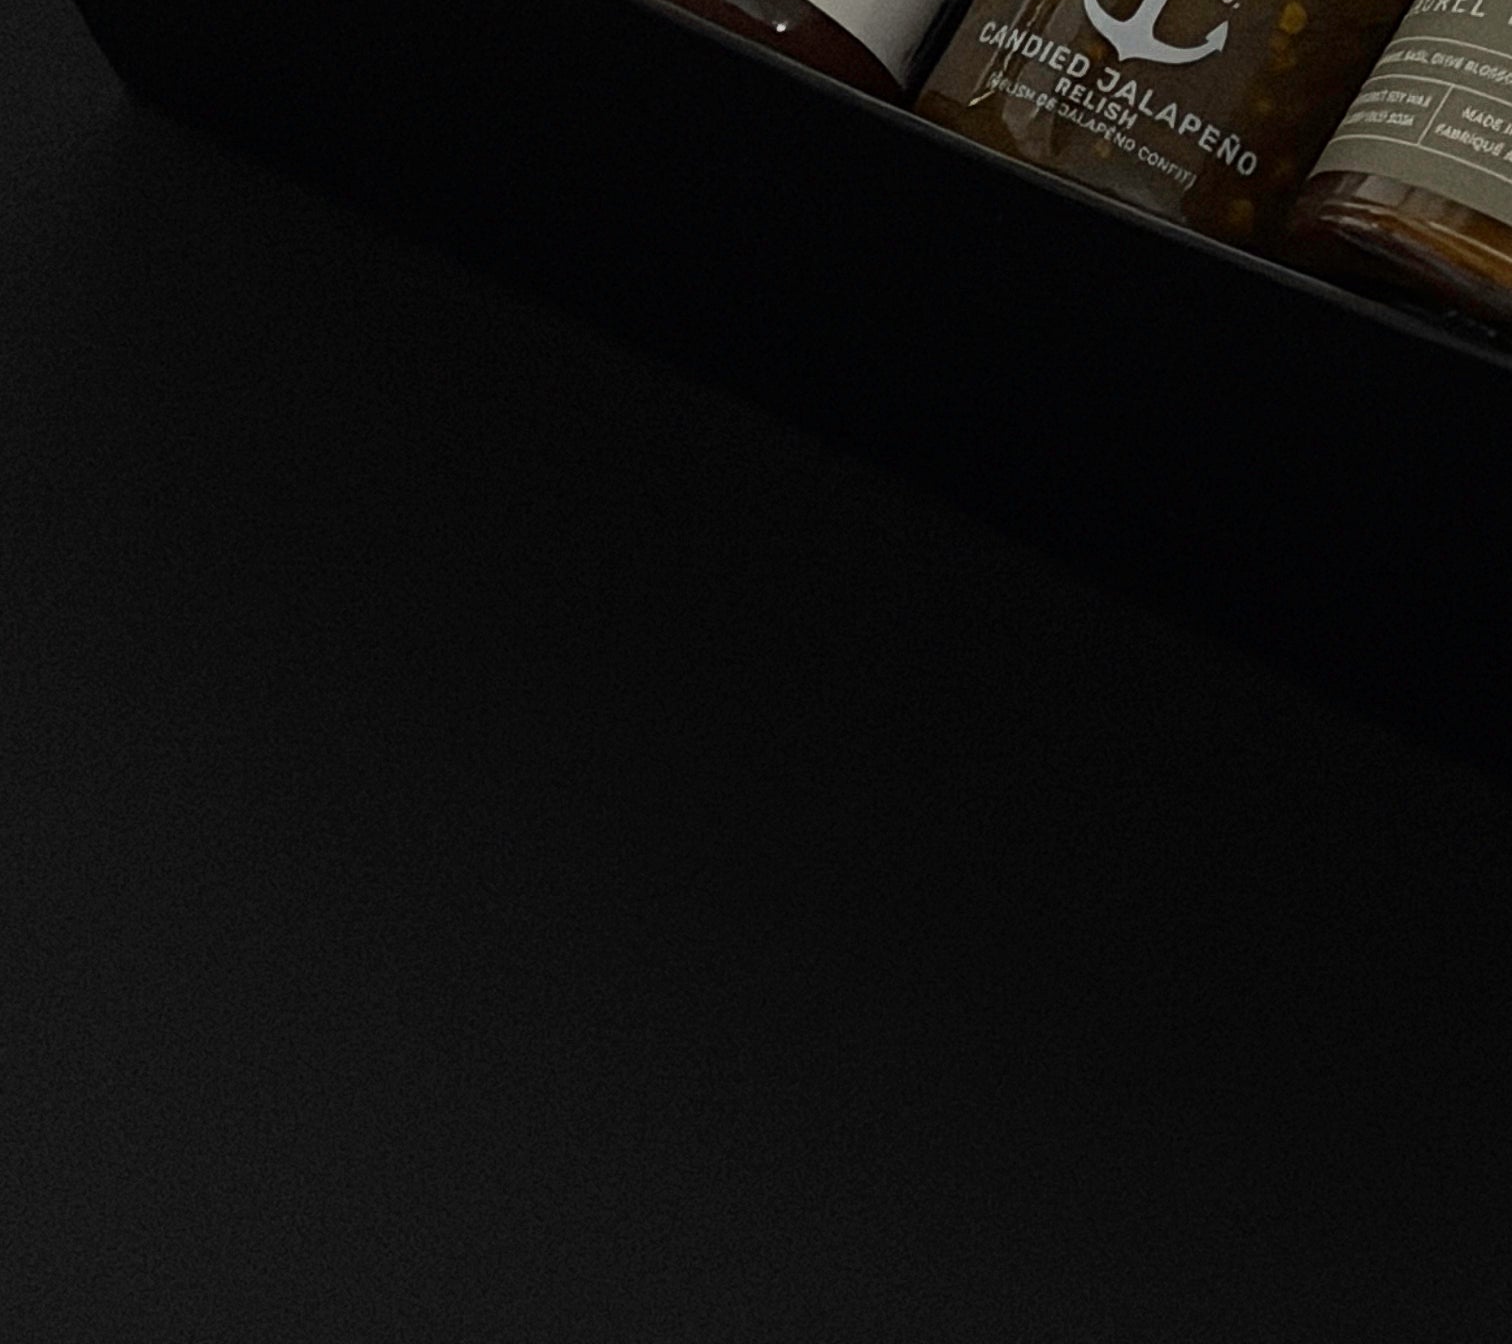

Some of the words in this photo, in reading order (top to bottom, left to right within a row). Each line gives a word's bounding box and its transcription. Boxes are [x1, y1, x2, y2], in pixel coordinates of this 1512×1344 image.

[978, 20, 1091, 79] CANDIED
[1096, 66, 1259, 176] JALAPEÑO
[1054, 76, 1139, 130] RELISH
[1462, 106, 1504, 132] MADE
[1434, 123, 1505, 156] FABRIQUÉ
